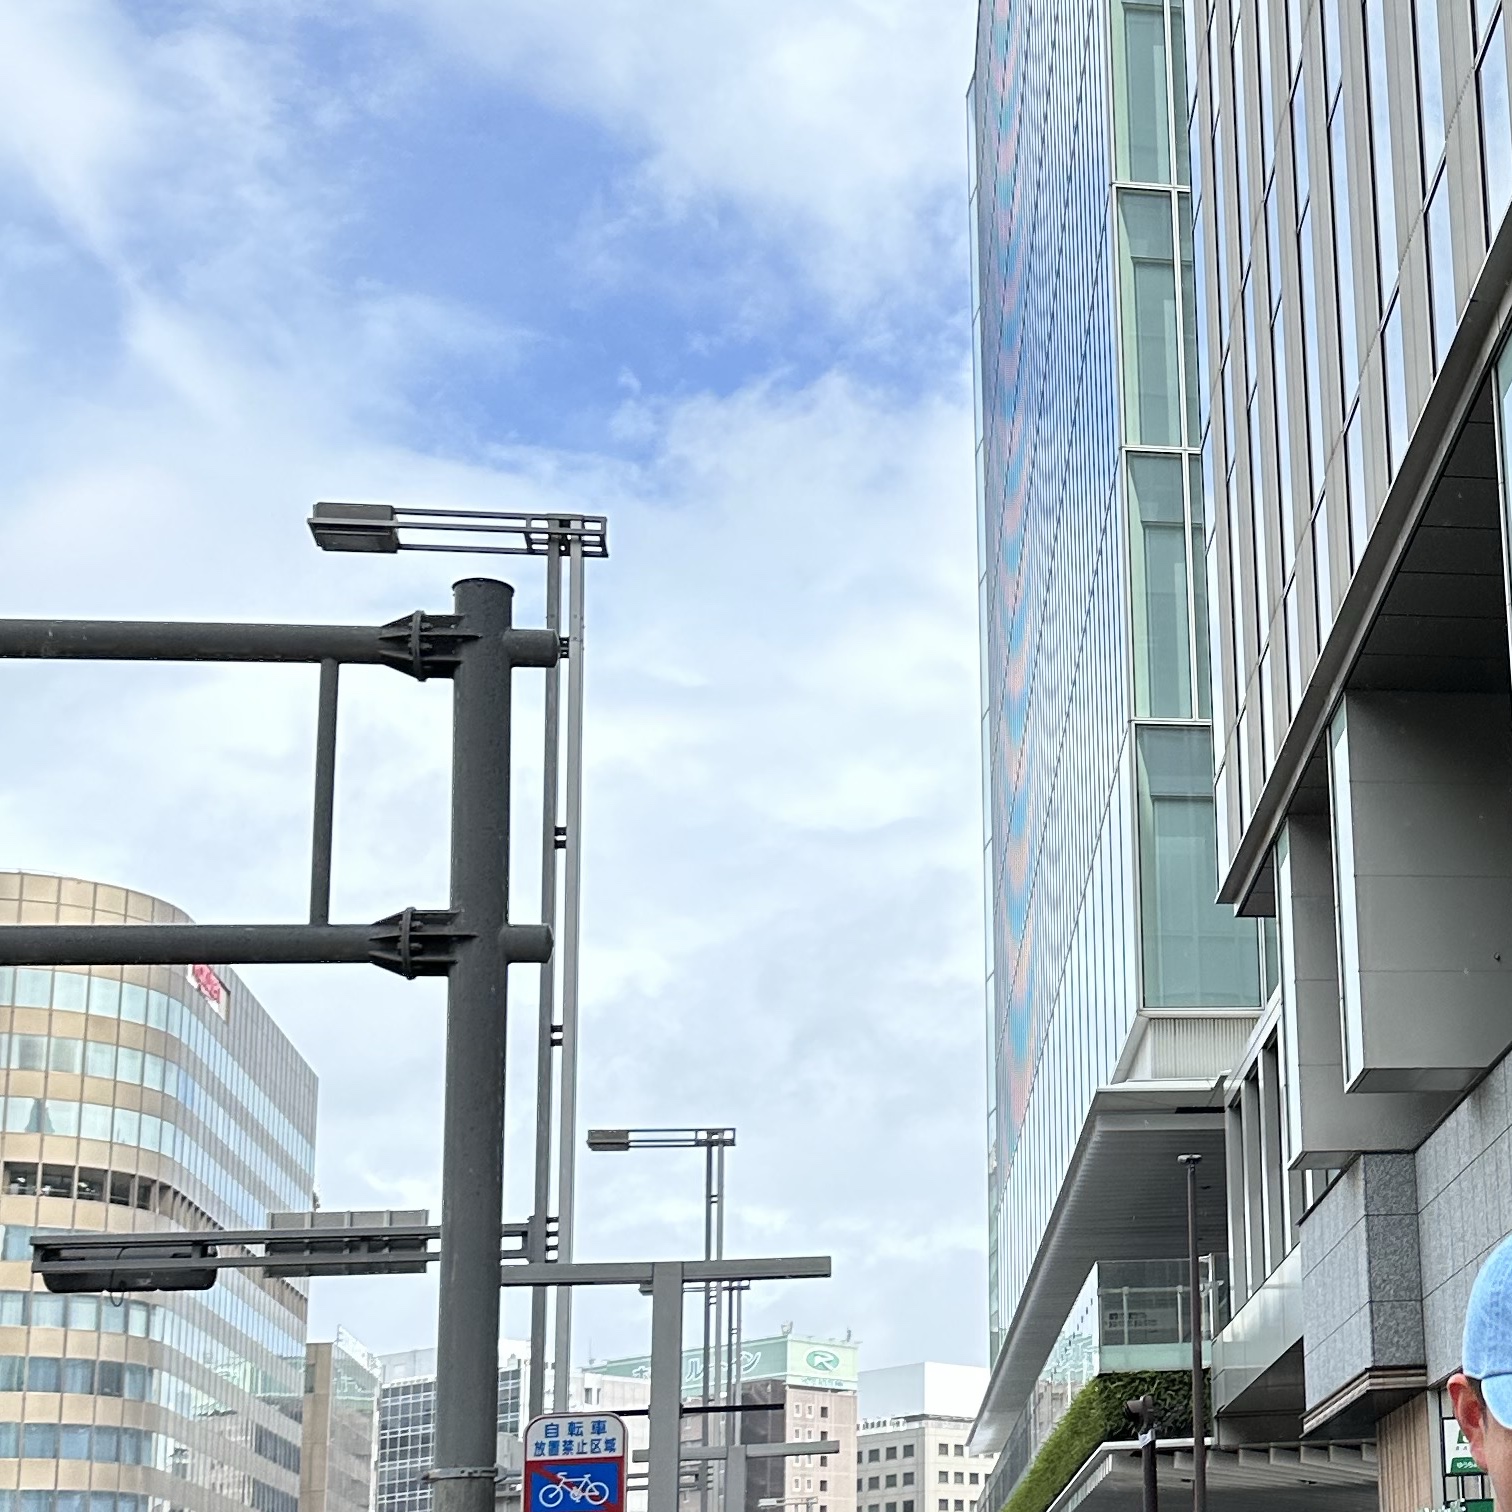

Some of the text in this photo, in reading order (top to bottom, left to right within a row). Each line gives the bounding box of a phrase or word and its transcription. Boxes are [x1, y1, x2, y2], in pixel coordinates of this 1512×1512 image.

[544, 1420, 608, 1438] 自転車
[533, 1438, 617, 1457] 放置禁止区域
